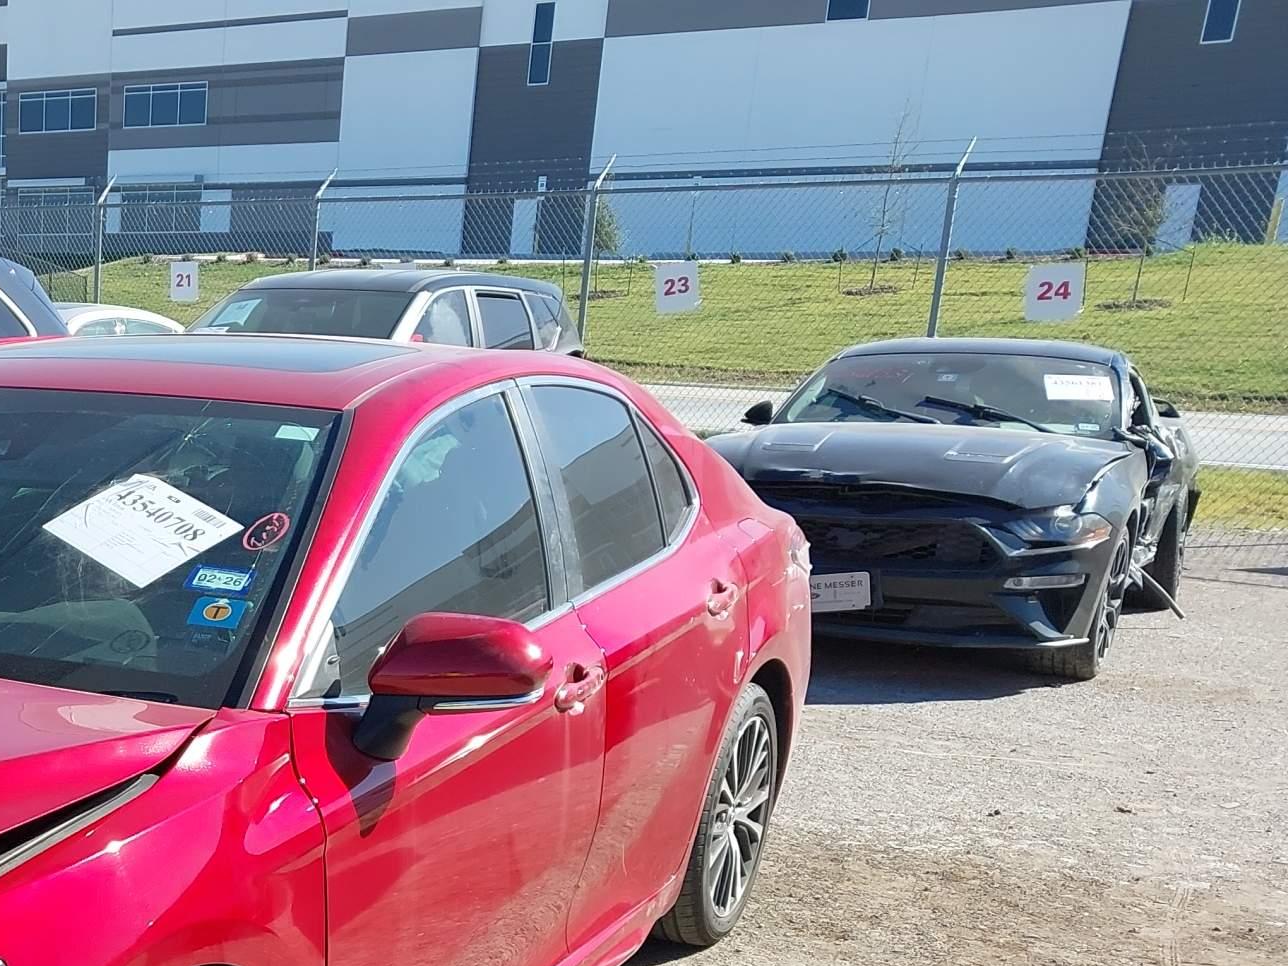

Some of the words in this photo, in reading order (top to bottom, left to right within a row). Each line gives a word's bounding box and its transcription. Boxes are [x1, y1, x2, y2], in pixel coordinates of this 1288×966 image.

[176, 273, 191, 288] 21
[663, 276, 690, 297] 23
[1036, 280, 1072, 301] 24
[116, 489, 206, 541] 43540708
[824, 579, 864, 590] MESSER
[212, 606, 228, 619] T
